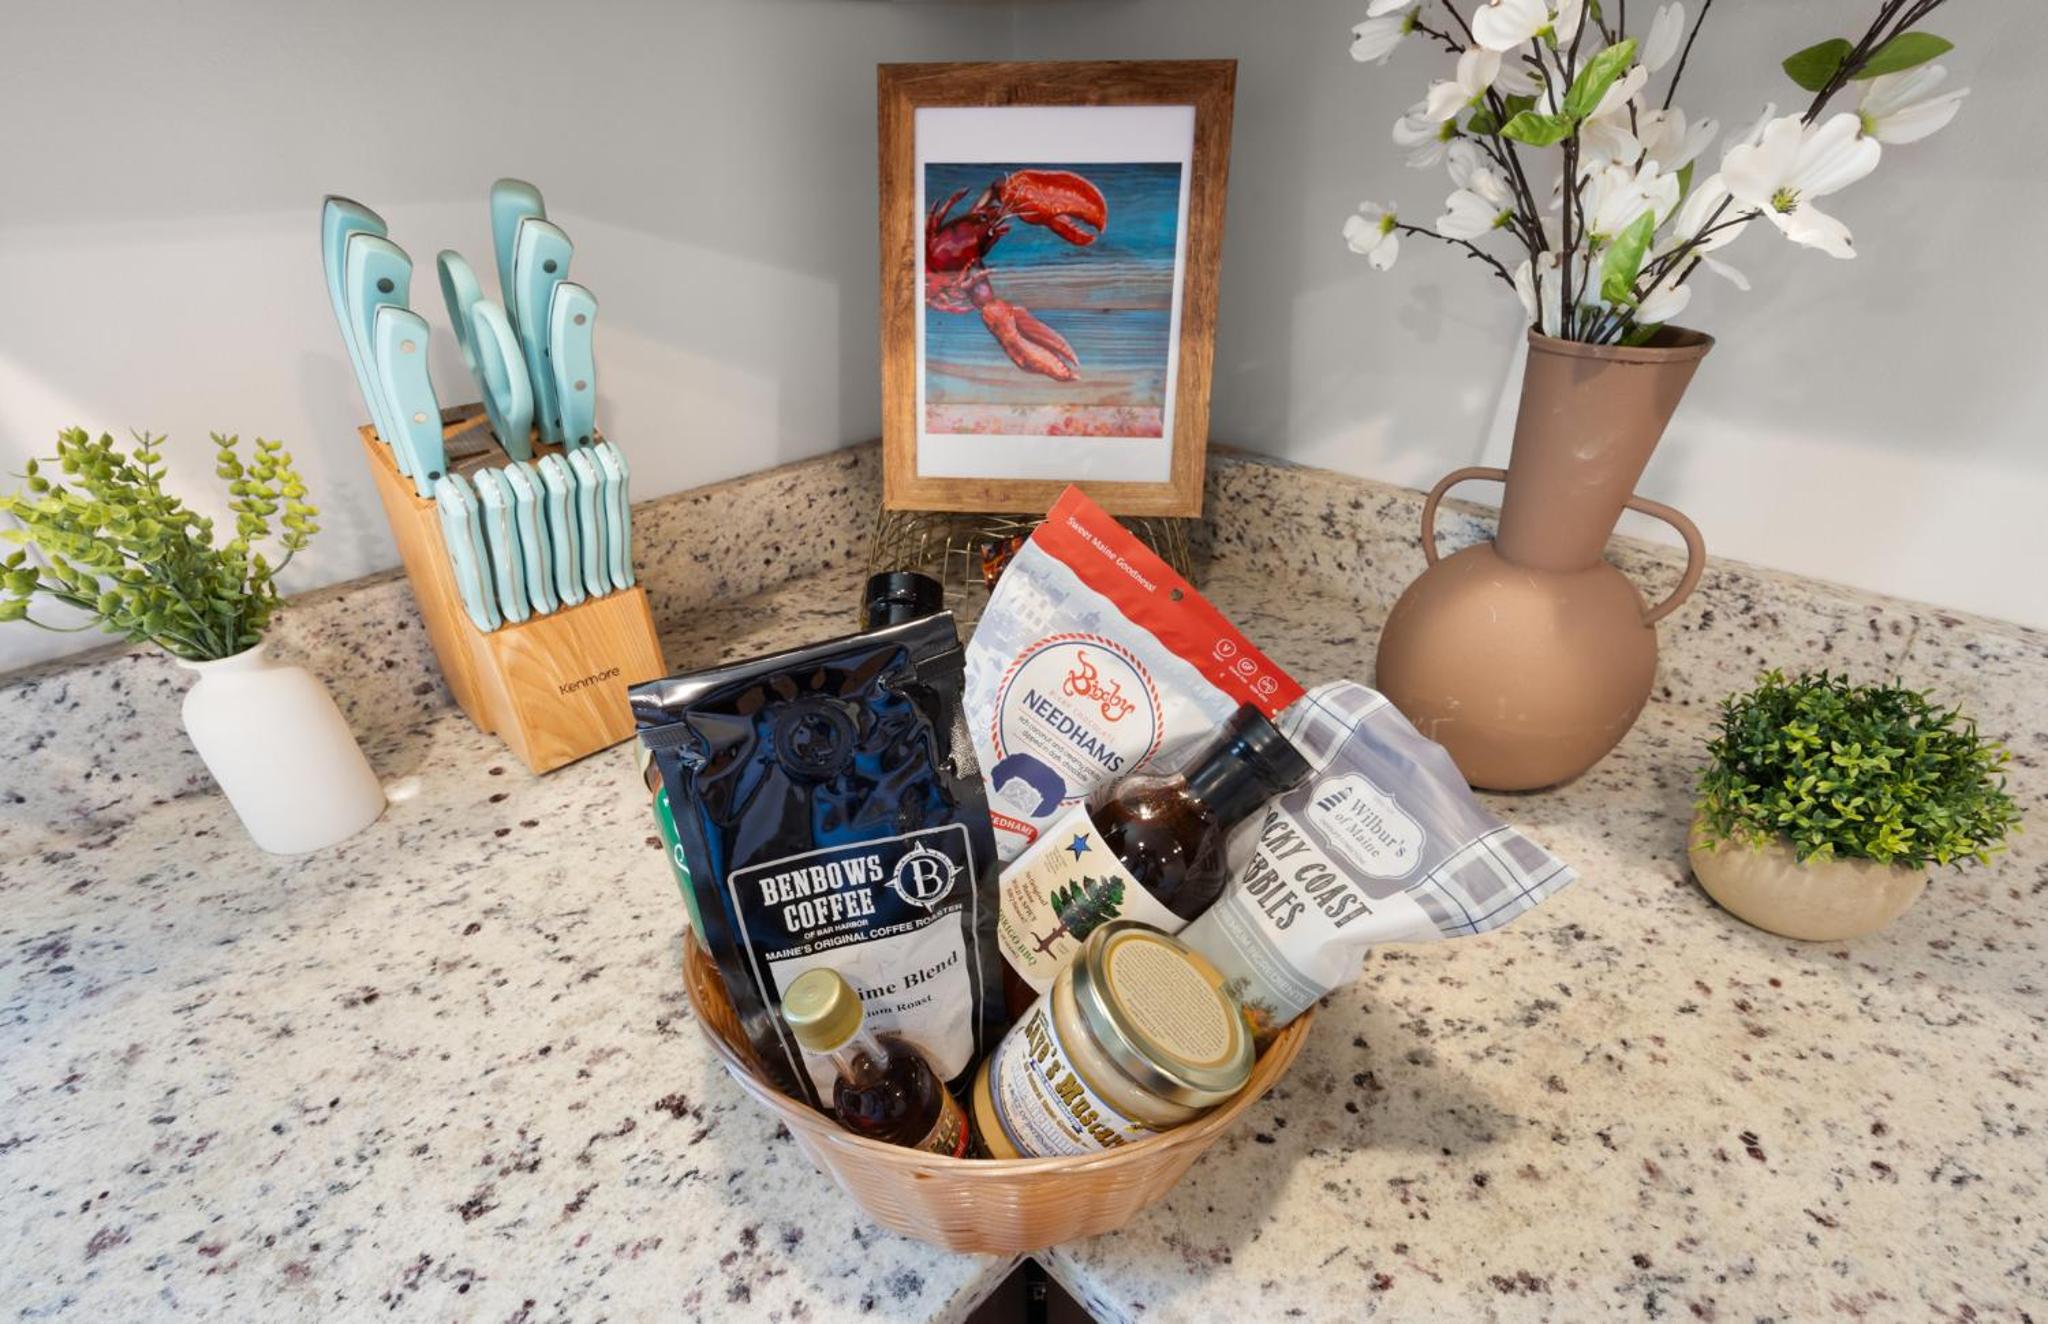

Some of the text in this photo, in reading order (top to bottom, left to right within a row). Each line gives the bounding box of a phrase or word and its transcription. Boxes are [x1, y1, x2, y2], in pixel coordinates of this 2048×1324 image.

[1066, 516, 1157, 592] Sweet Maine Goodness!
[559, 667, 620, 695] Kenmore
[1062, 650, 1136, 722] Bixby
[1022, 688, 1125, 773] NEEDHAMS
[991, 814, 1033, 836] EDHAMS
[1335, 813, 1353, 825] of
[1345, 823, 1380, 858] Maine
[1351, 798, 1406, 858] Wilbur's
[759, 854, 884, 907] BENBOWS
[910, 857, 944, 899] B
[1241, 851, 1306, 931] EBBLES
[1260, 806, 1312, 861] OCKY
[1293, 862, 1373, 929] COAST
[765, 903, 963, 962] MAINE'S ORIGINAL COFFEE ROASTER
[783, 887, 876, 933] COFFEE
[804, 918, 869, 940] OF BAR HARBOR
[857, 950, 958, 1001] ime Blend
[866, 994, 933, 1018] ium Roast
[1055, 1072, 1126, 1148] Mustar
